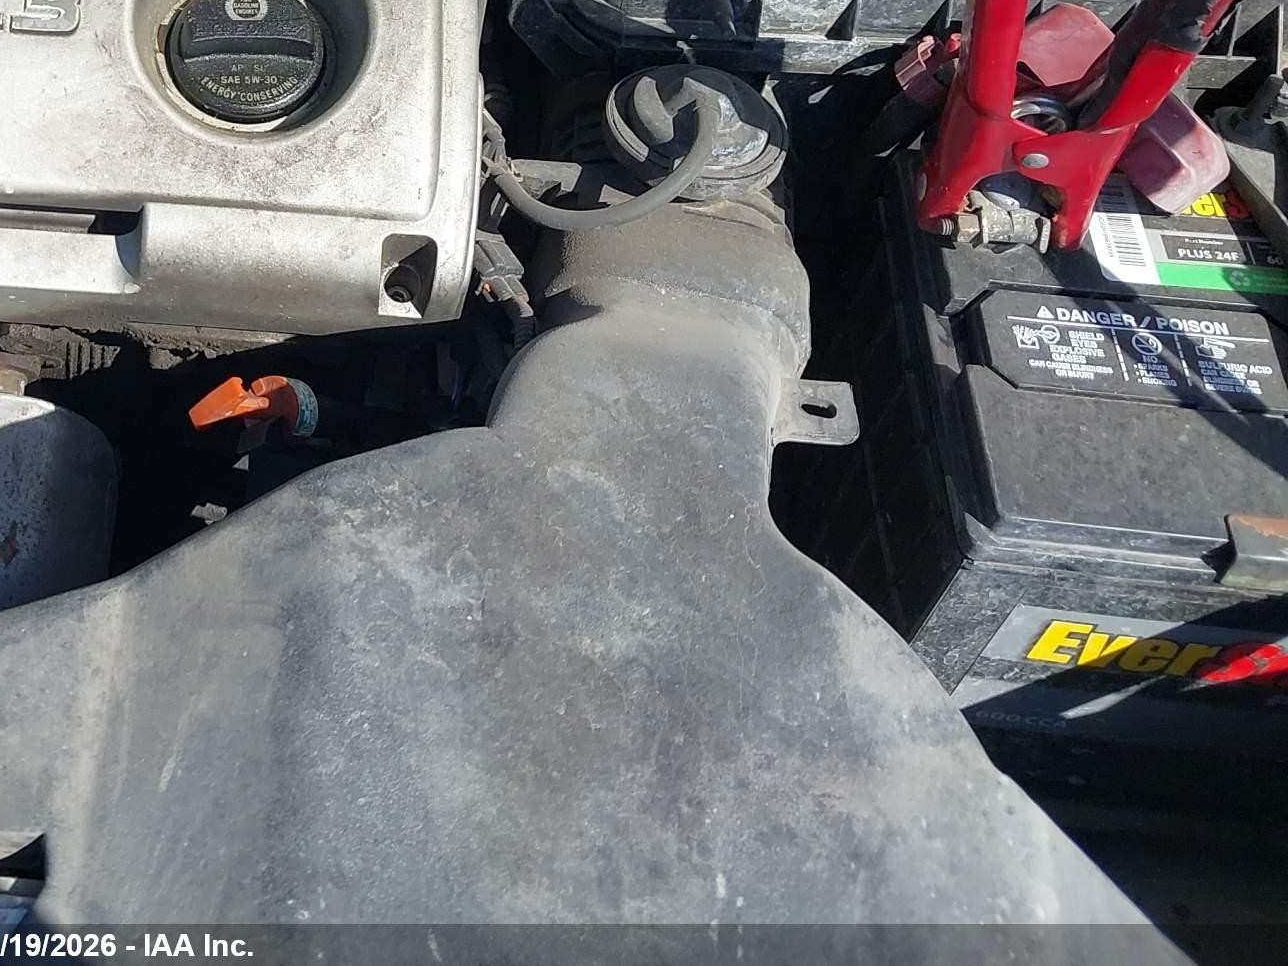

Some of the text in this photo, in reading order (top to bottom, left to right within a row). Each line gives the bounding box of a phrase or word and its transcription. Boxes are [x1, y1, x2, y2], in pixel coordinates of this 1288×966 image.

[220, 75, 278, 84] SAE 5W-30
[200, 76, 299, 102] ENERGY CONSERVING
[1177, 248, 1241, 261] PLUS 24F
[1055, 306, 1136, 327] DANGER
[1156, 316, 1230, 335] POISON
[1068, 330, 1105, 341] SHIELD
[1070, 338, 1098, 349] EYES
[1049, 344, 1105, 357] EXPLOSIVE
[1051, 353, 1087, 364] GASES
[1141, 354, 1158, 364] NO
[1198, 360, 1273, 375] SULFURIC ACID
